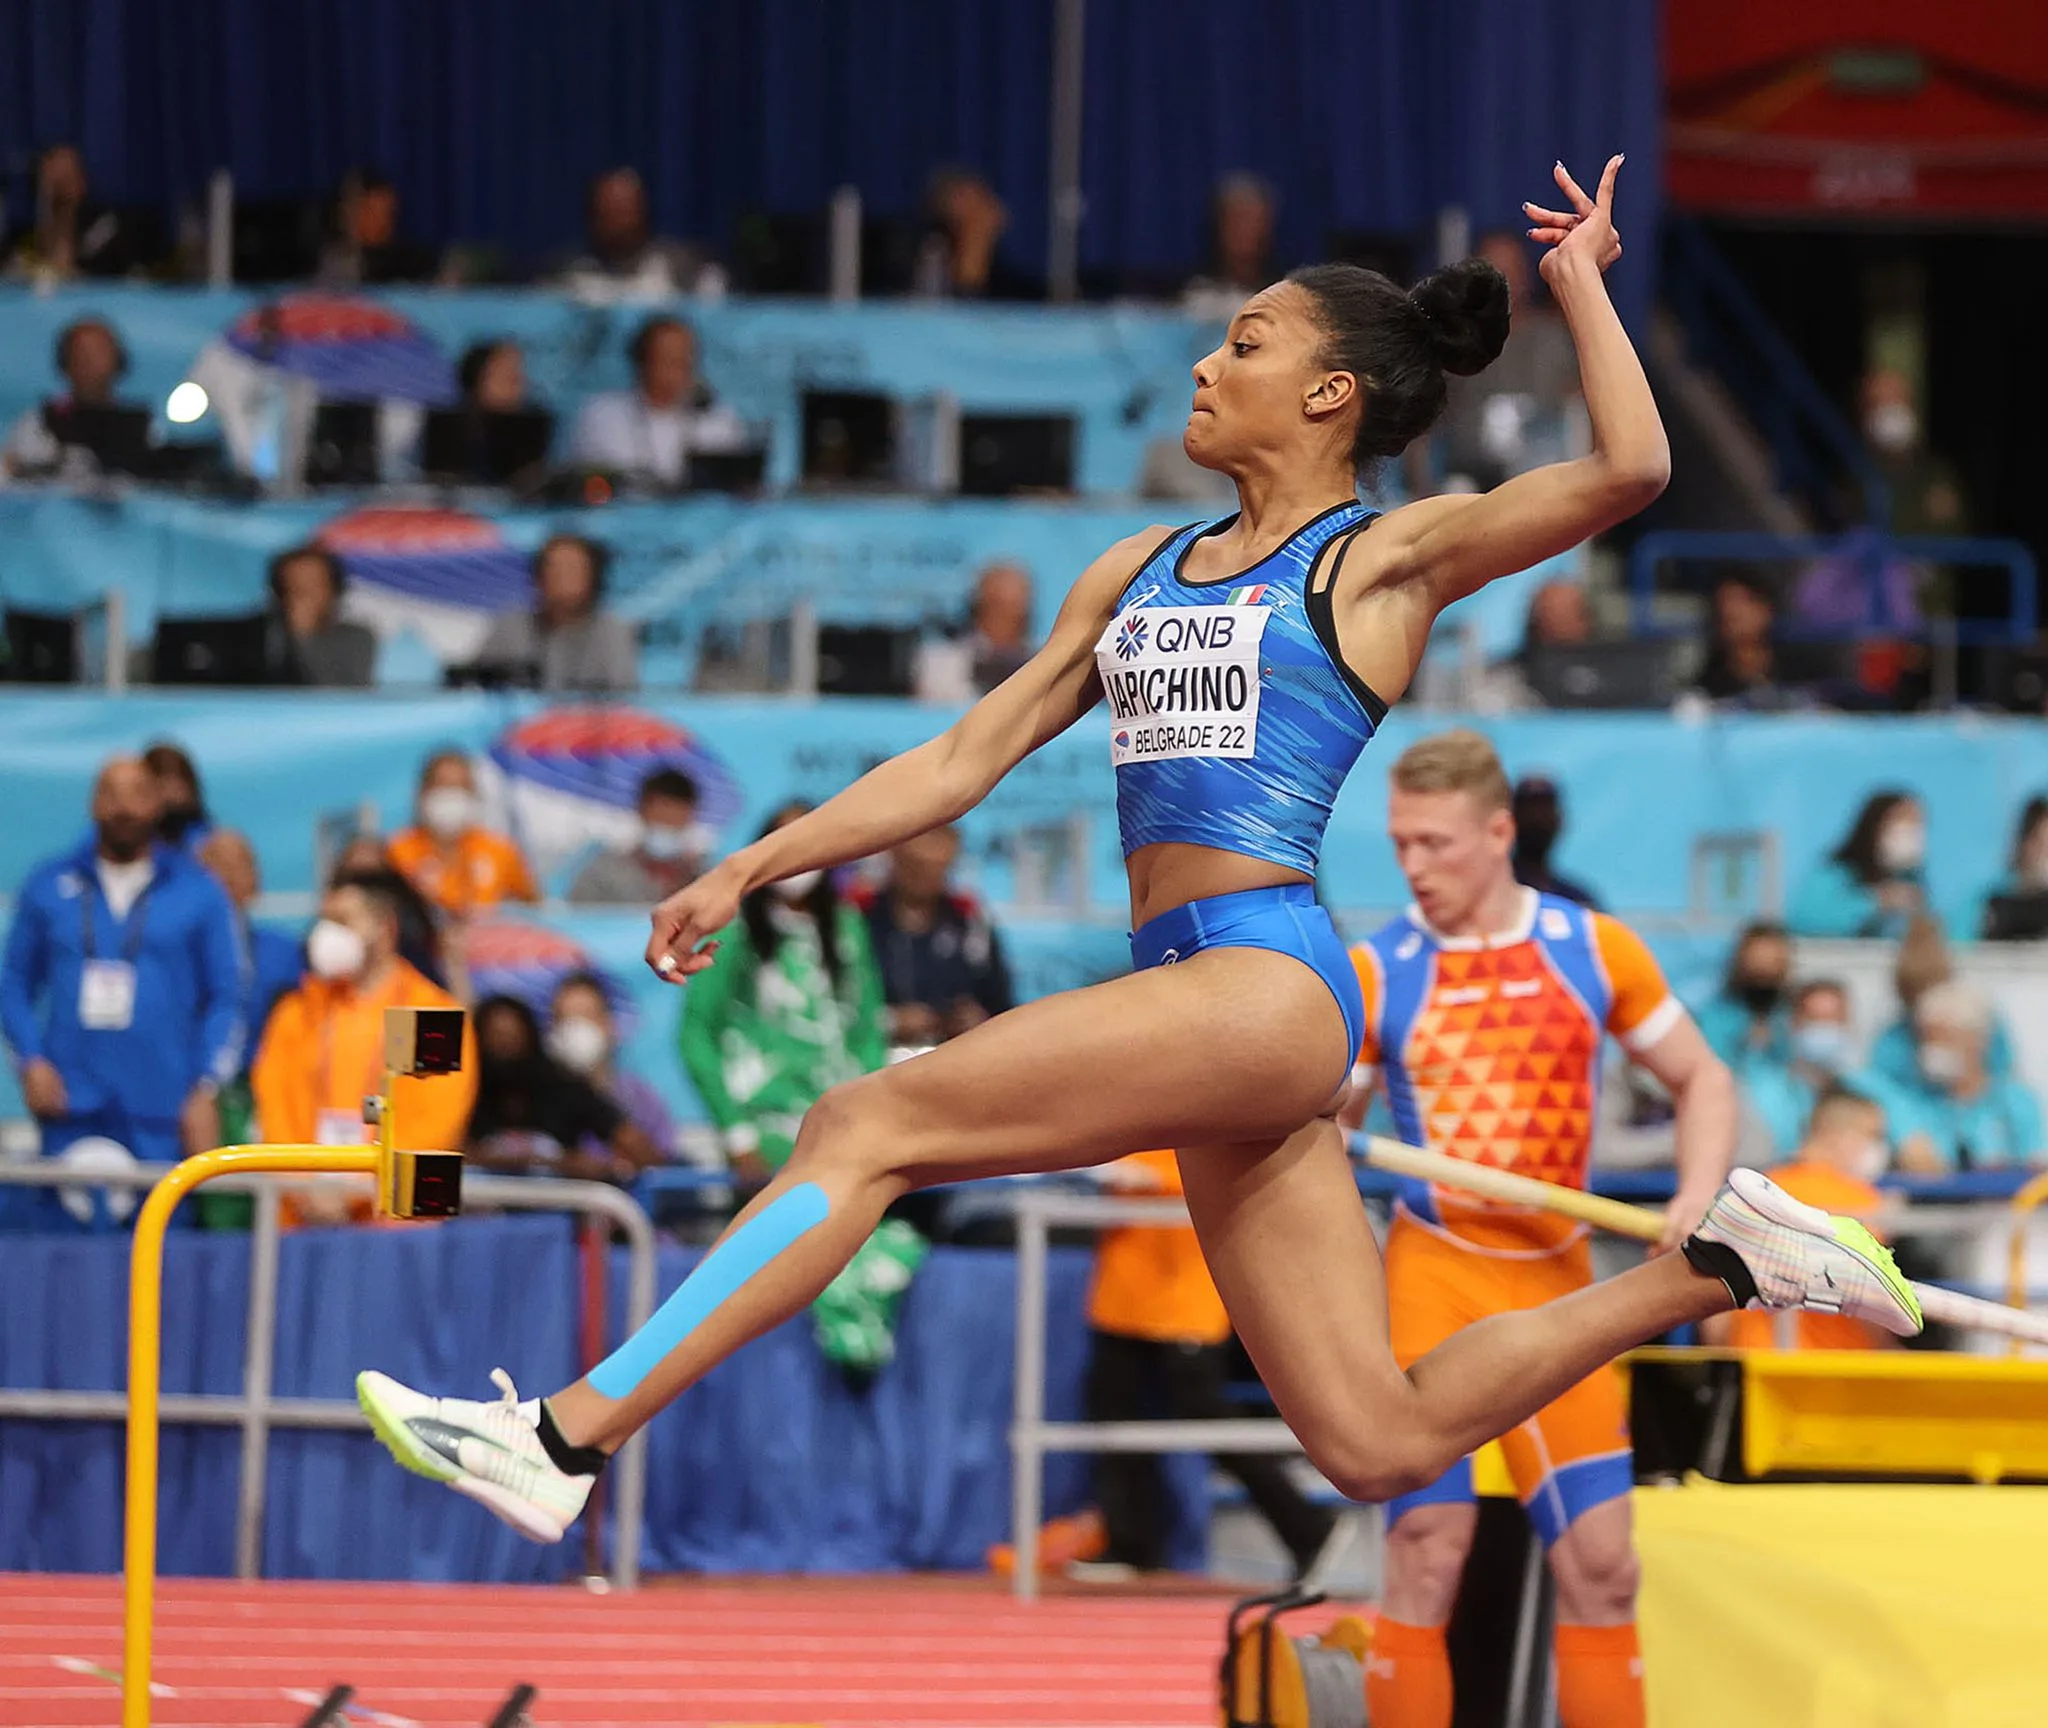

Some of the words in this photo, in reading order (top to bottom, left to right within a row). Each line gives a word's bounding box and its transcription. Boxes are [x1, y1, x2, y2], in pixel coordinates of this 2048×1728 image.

[1156, 616, 1236, 653] QNB
[1106, 664, 1248, 719] IAPICHINO
[1135, 725, 1214, 754] BELGRADE
[1218, 725, 1246, 749] 22
